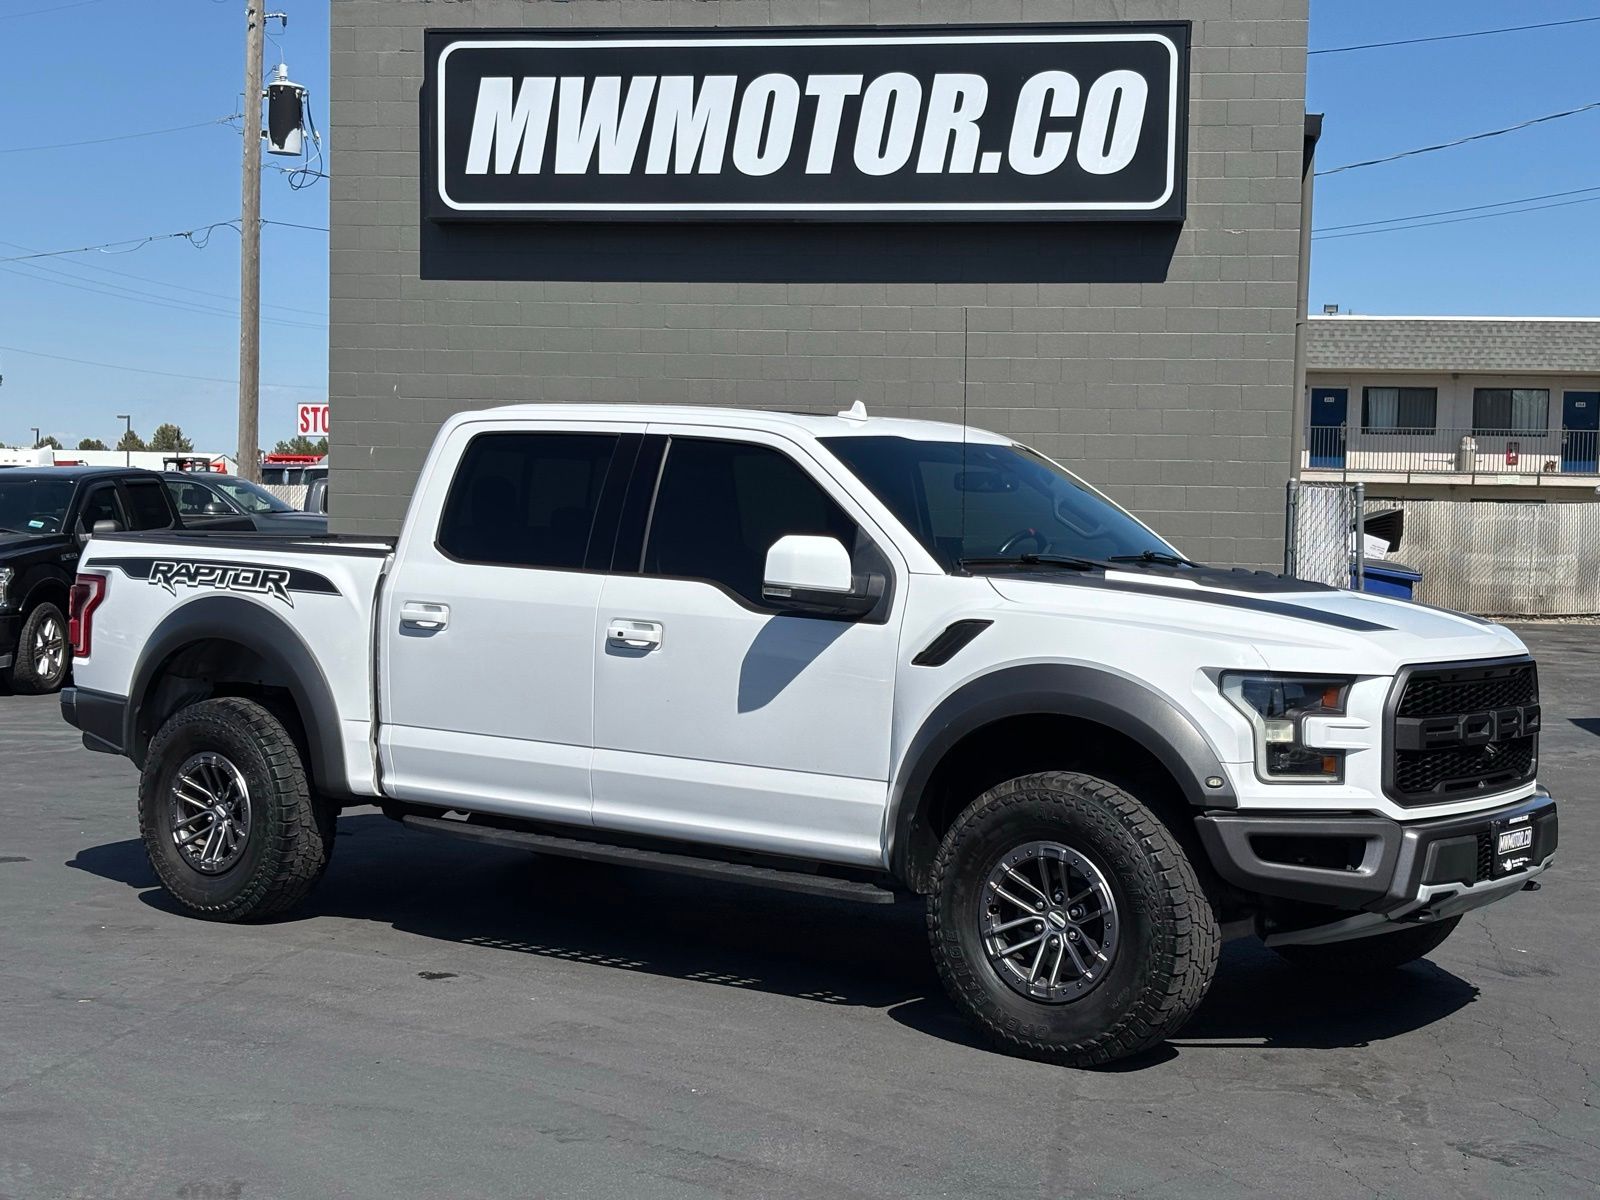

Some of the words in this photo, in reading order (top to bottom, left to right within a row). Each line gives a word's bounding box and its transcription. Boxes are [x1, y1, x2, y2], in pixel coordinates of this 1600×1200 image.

[465, 69, 1148, 177] MWMOTOR.CO
[300, 406, 329, 433] STO
[148, 560, 295, 609] RAPTOR
[1400, 705, 1541, 750] FORD
